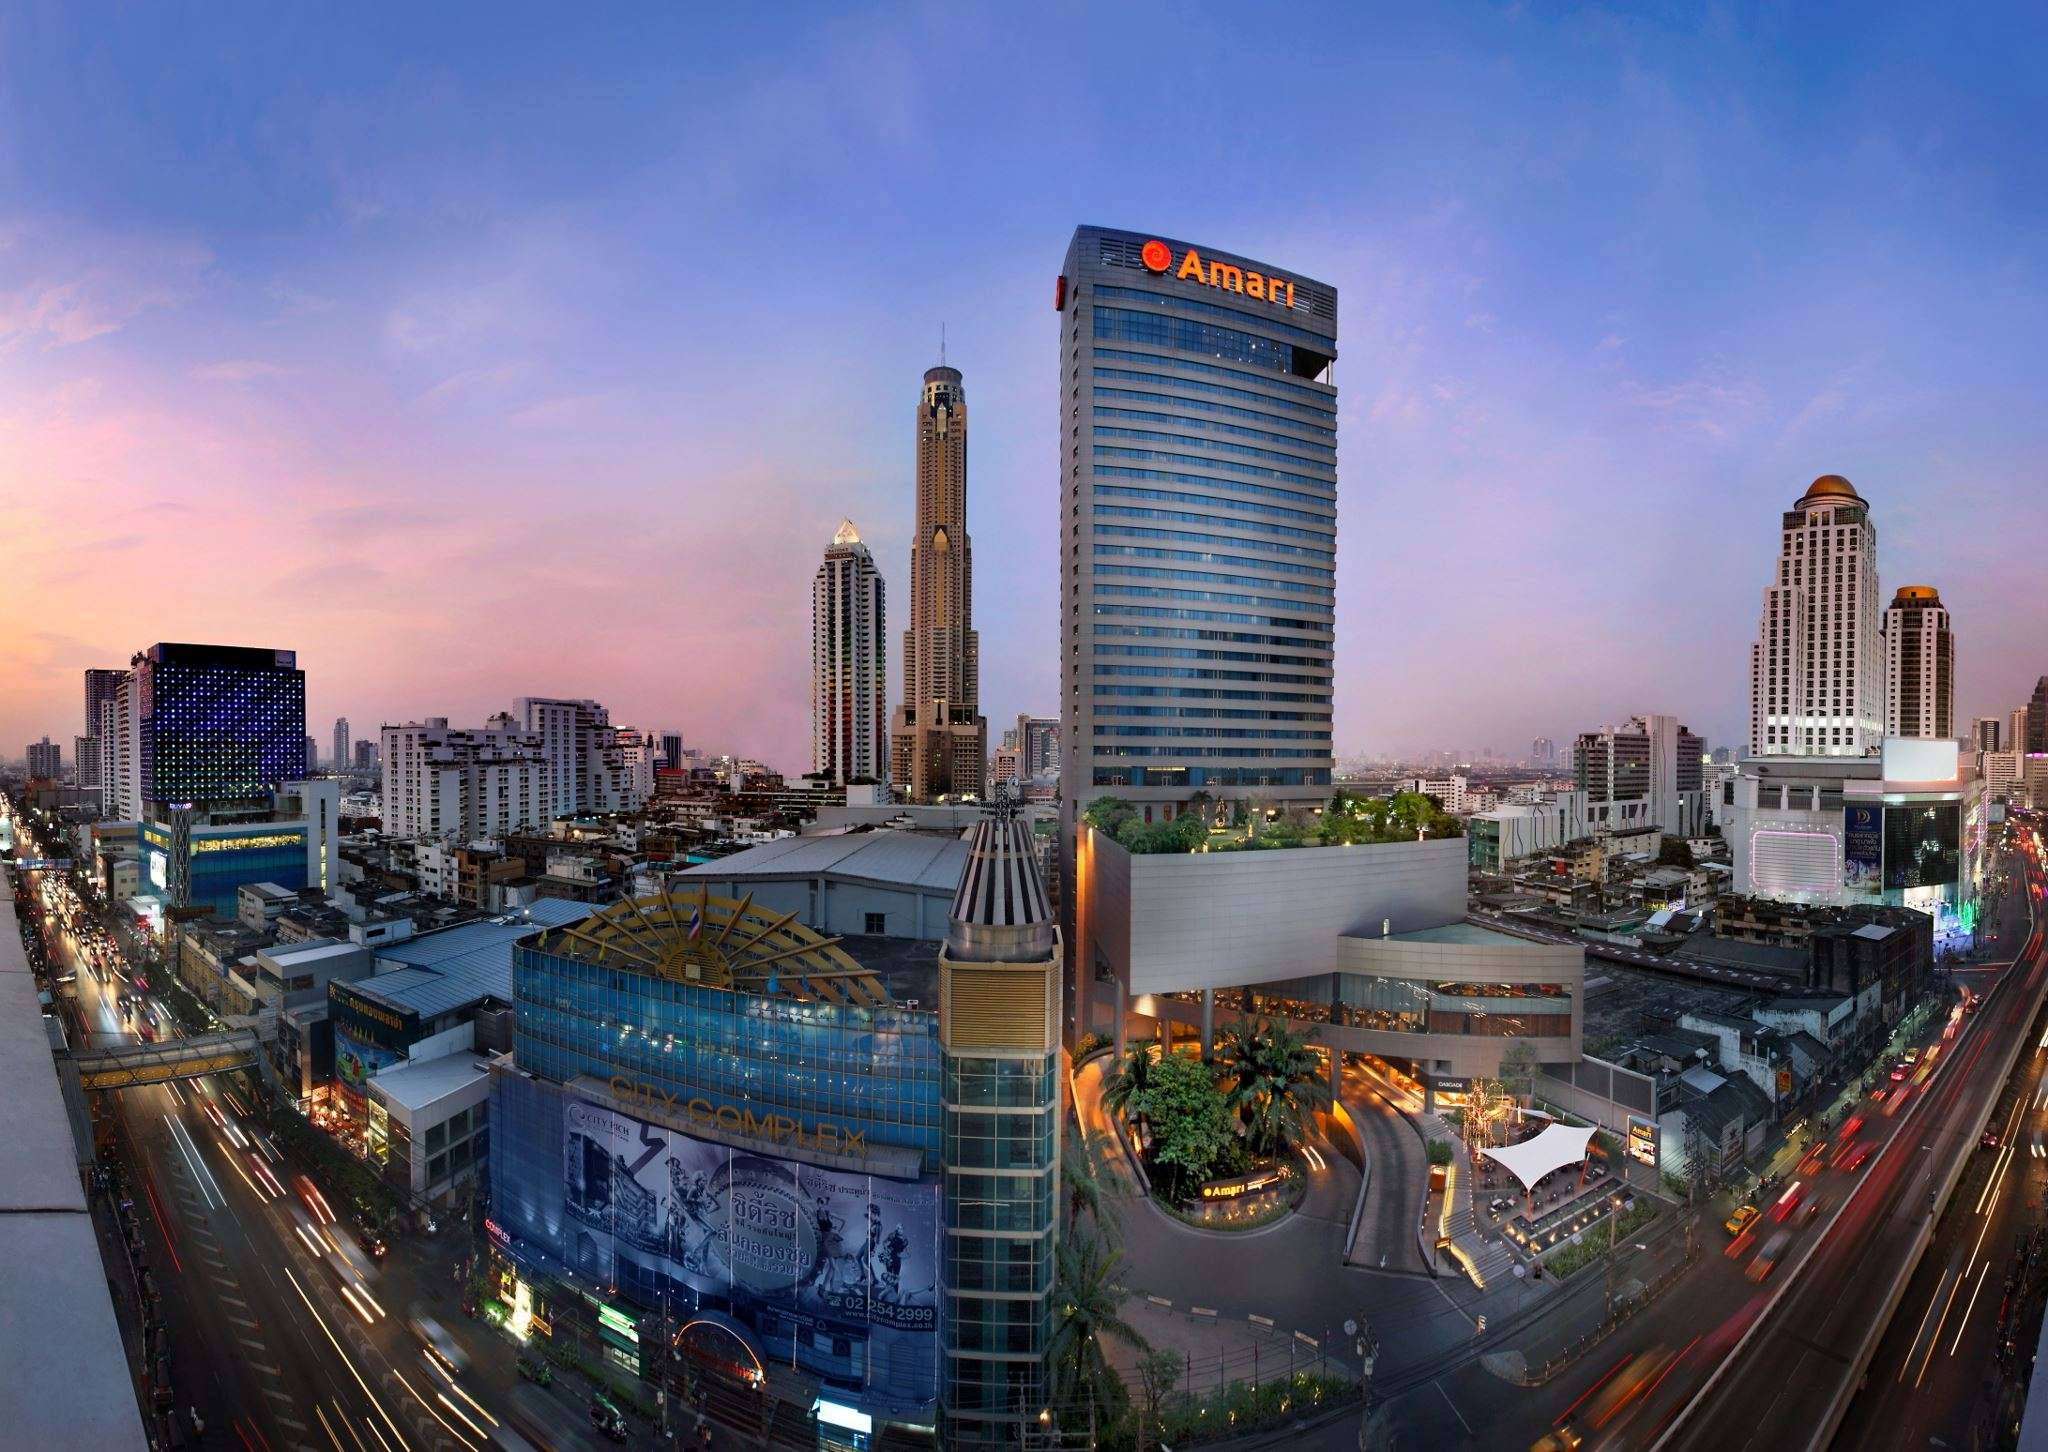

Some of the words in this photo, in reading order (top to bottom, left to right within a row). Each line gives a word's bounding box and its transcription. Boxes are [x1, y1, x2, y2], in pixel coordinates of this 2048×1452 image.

[1176, 249, 1295, 310] Amari
[608, 1075, 678, 1116] CITY
[688, 1098, 867, 1156] COMPLEX
[845, 1296, 864, 1310] 02
[869, 1300, 894, 1318] 254
[896, 1307, 933, 1321] 2999
